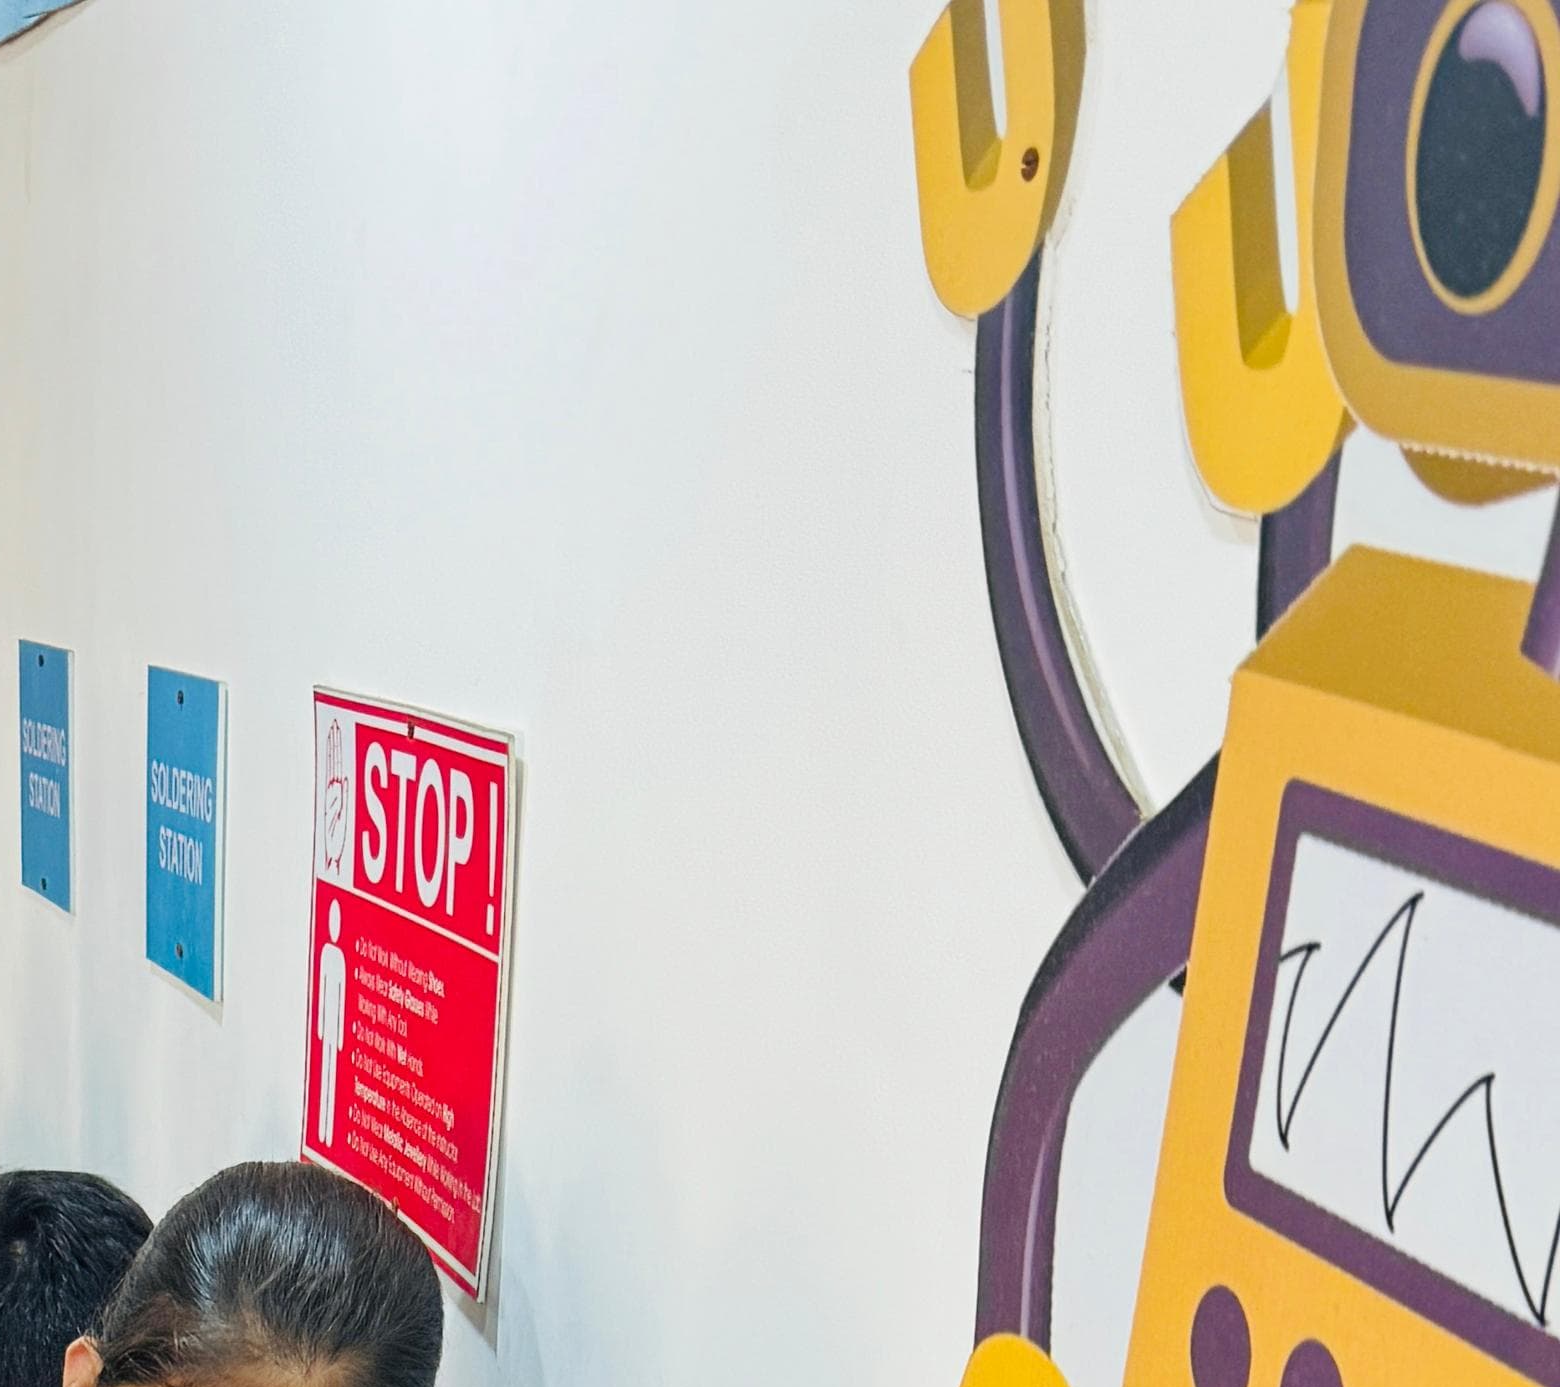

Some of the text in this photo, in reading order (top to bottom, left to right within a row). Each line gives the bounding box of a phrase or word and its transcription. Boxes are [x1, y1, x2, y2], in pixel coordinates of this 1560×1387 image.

[22, 718, 67, 767] SOLDERING
[28, 772, 61, 819] STATION
[151, 760, 213, 824] SOLDERING
[159, 825, 203, 886] STATION
[361, 740, 499, 938] STOP !
